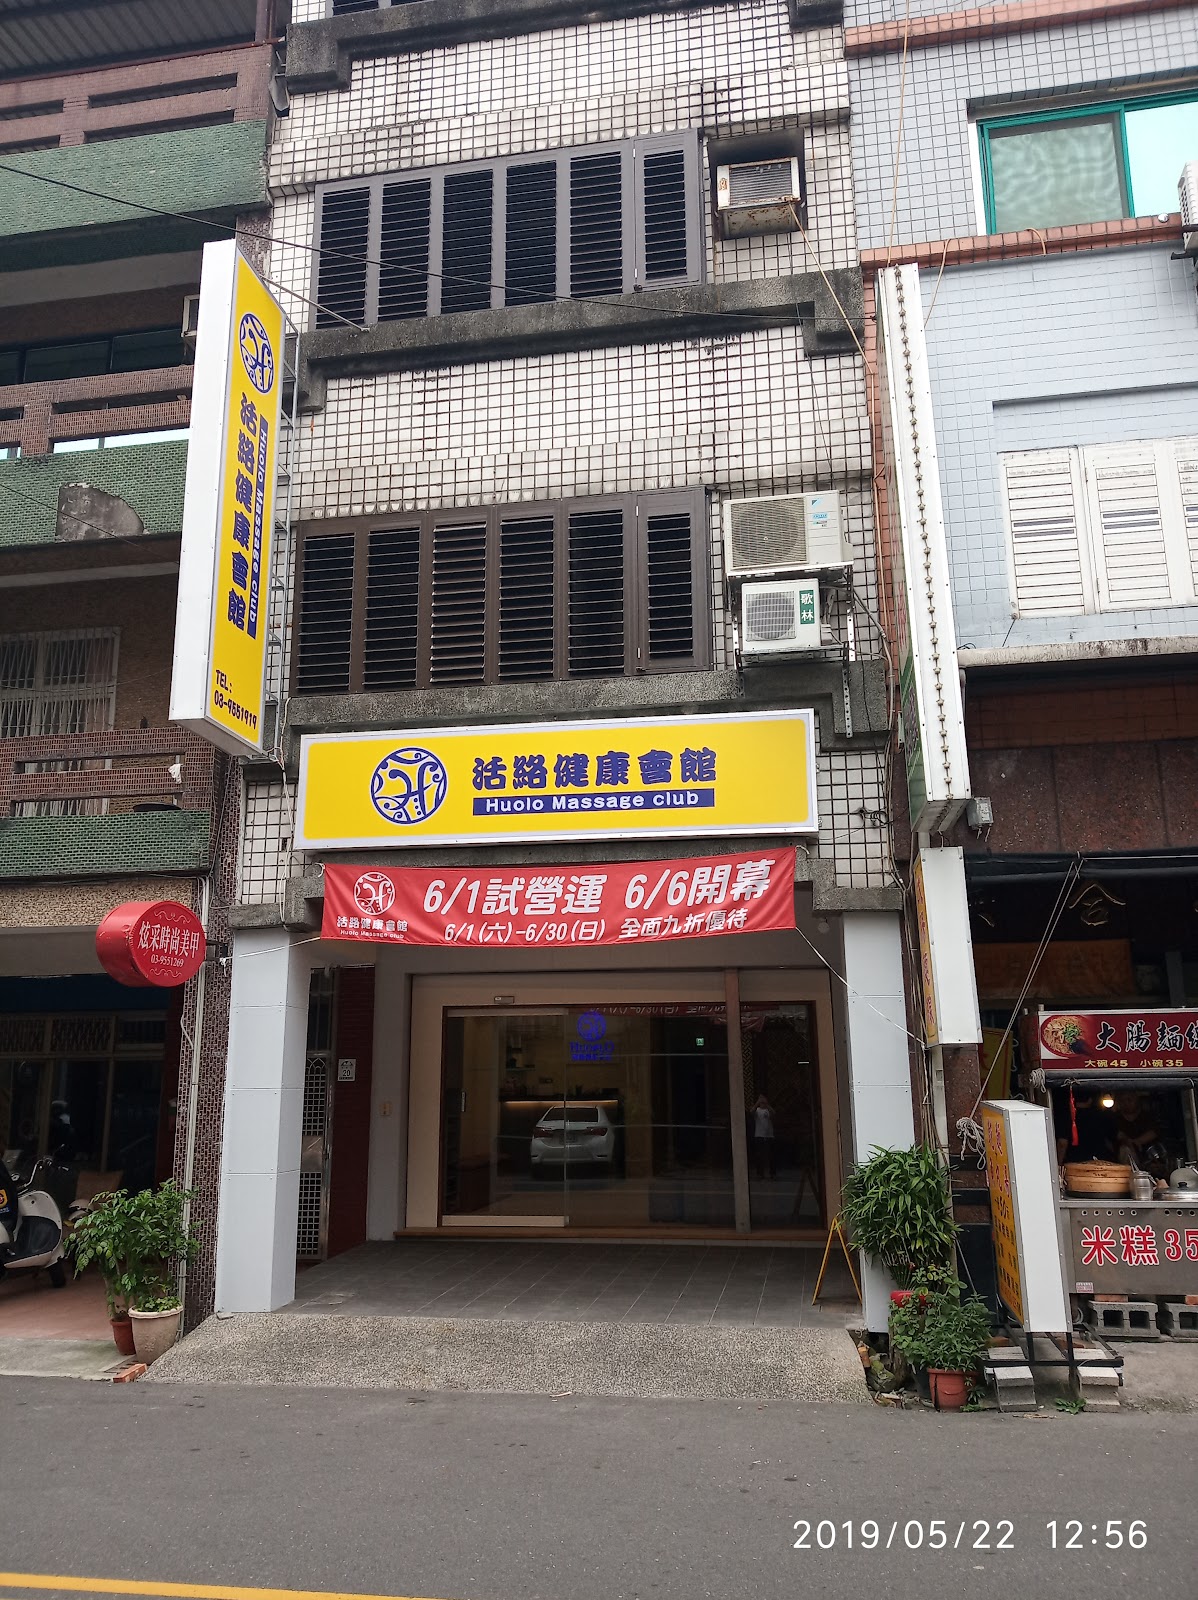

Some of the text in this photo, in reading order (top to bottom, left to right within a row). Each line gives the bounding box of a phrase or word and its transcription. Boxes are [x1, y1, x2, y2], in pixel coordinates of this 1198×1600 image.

[228, 392, 258, 631] 活絡健康會館
[250, 431, 267, 623] Huolo Massage club
[800, 592, 814, 622] 歌林
[214, 690, 257, 730] 03-9551919
[472, 747, 717, 791] 活絡健康會館
[486, 790, 699, 813] Huolo Massage club
[423, 859, 776, 916] 6/1試營運 6/6開幕
[137, 920, 200, 958] 炫采時尚美甲
[336, 915, 408, 933] 活絡健康會館
[618, 908, 749, 940] 全面九折優待
[150, 953, 184, 968] 03-9551269
[342, 1069, 351, 1077] 20
